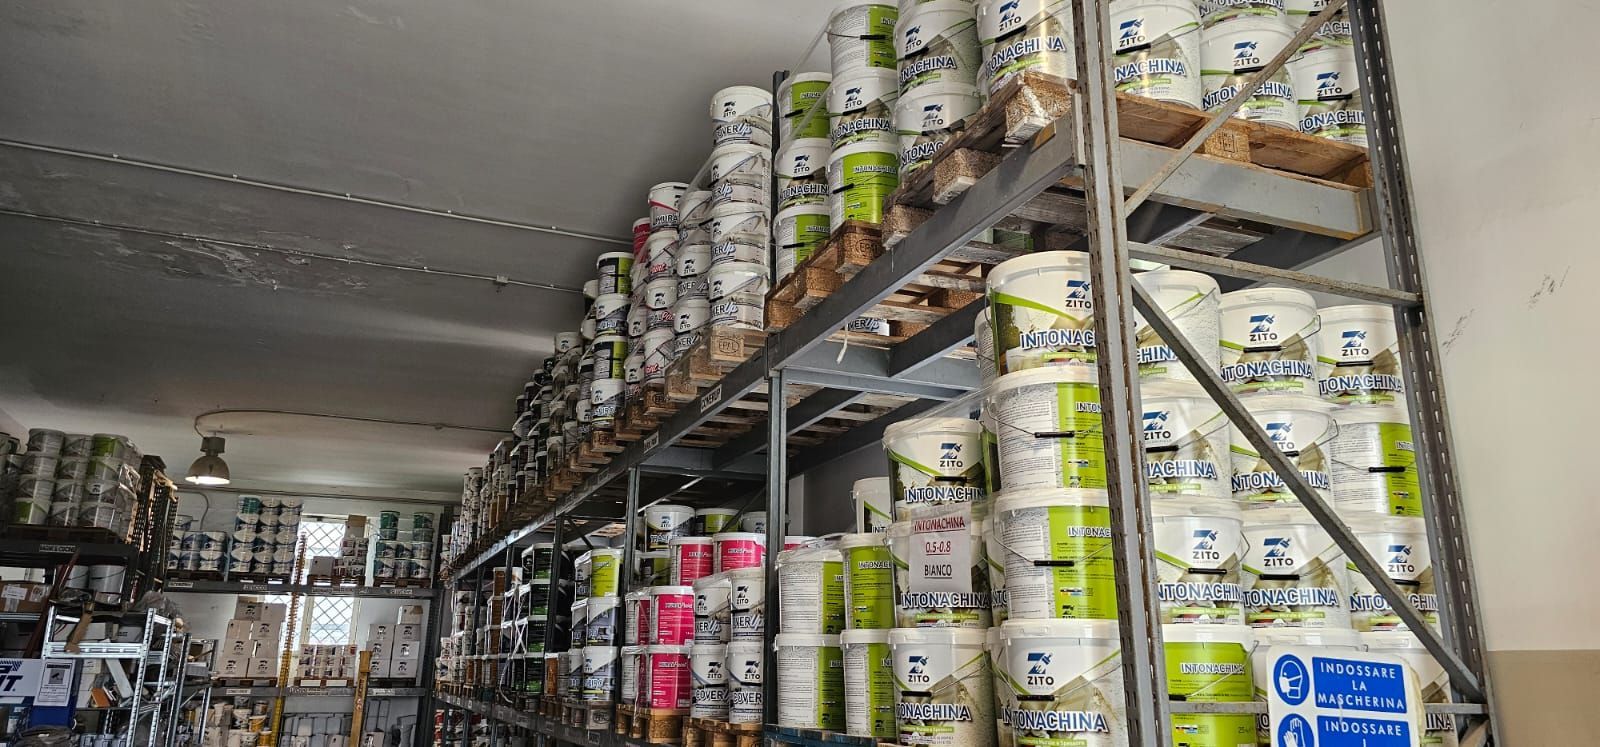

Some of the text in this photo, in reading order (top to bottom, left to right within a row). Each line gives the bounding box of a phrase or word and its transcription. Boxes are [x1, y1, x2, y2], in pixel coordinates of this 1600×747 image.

[998, 16, 1021, 31] ZITO
[905, 40, 922, 53] ZITO
[1119, 36, 1146, 48] ZITO
[987, 36, 1066, 77] ONACHINA
[1233, 57, 1260, 67] ZITO
[900, 56, 957, 84] NACHINA
[1115, 59, 1187, 81] NACHINA
[1317, 88, 1342, 97] ZITO
[844, 99, 862, 110] ZITO
[922, 119, 943, 129] ZITO
[1299, 110, 1367, 132] TONACHIN
[832, 118, 892, 143] TONACHINA
[901, 141, 945, 169] NTONAC
[794, 167, 809, 175] ZITO
[1065, 299, 1092, 309] ZITO
[1020, 329, 1097, 350] INTONAC
[1249, 333, 1278, 342] ZITO
[1341, 348, 1369, 356] ZITO
[1220, 359, 1314, 382] NTONACHINA
[1319, 375, 1404, 395] TONACHINA
[1144, 431, 1171, 440] ZITO
[939, 460, 963, 468] ZITO
[904, 485, 985, 504] INTONACHIN
[914, 516, 966, 531] INTONACHINA
[1068, 526, 1112, 538] INTONAC
[926, 541, 951, 553] 0.5-0.8
[1193, 551, 1220, 561] ZITO
[1263, 558, 1294, 567] ZITO
[924, 564, 952, 577] BIANCO
[1388, 565, 1415, 573] ZITO
[1158, 583, 1243, 601] NTONACHIN
[1243, 588, 1339, 607] TONACHINA
[1180, 662, 1244, 675] INTONACHINA
[1320, 662, 1396, 679] INDOSSARE
[908, 675, 930, 683] ZITO
[1027, 676, 1055, 686] ZITO
[1352, 680, 1367, 692] LA
[695, 688, 728, 701] COVER
[733, 691, 762, 704] COVER
[1317, 692, 1405, 710] MASCHERINA
[896, 702, 974, 721] ONACHINA
[1012, 708, 1110, 733] TONACHINA
[1325, 720, 1402, 736] INDOSSARE
